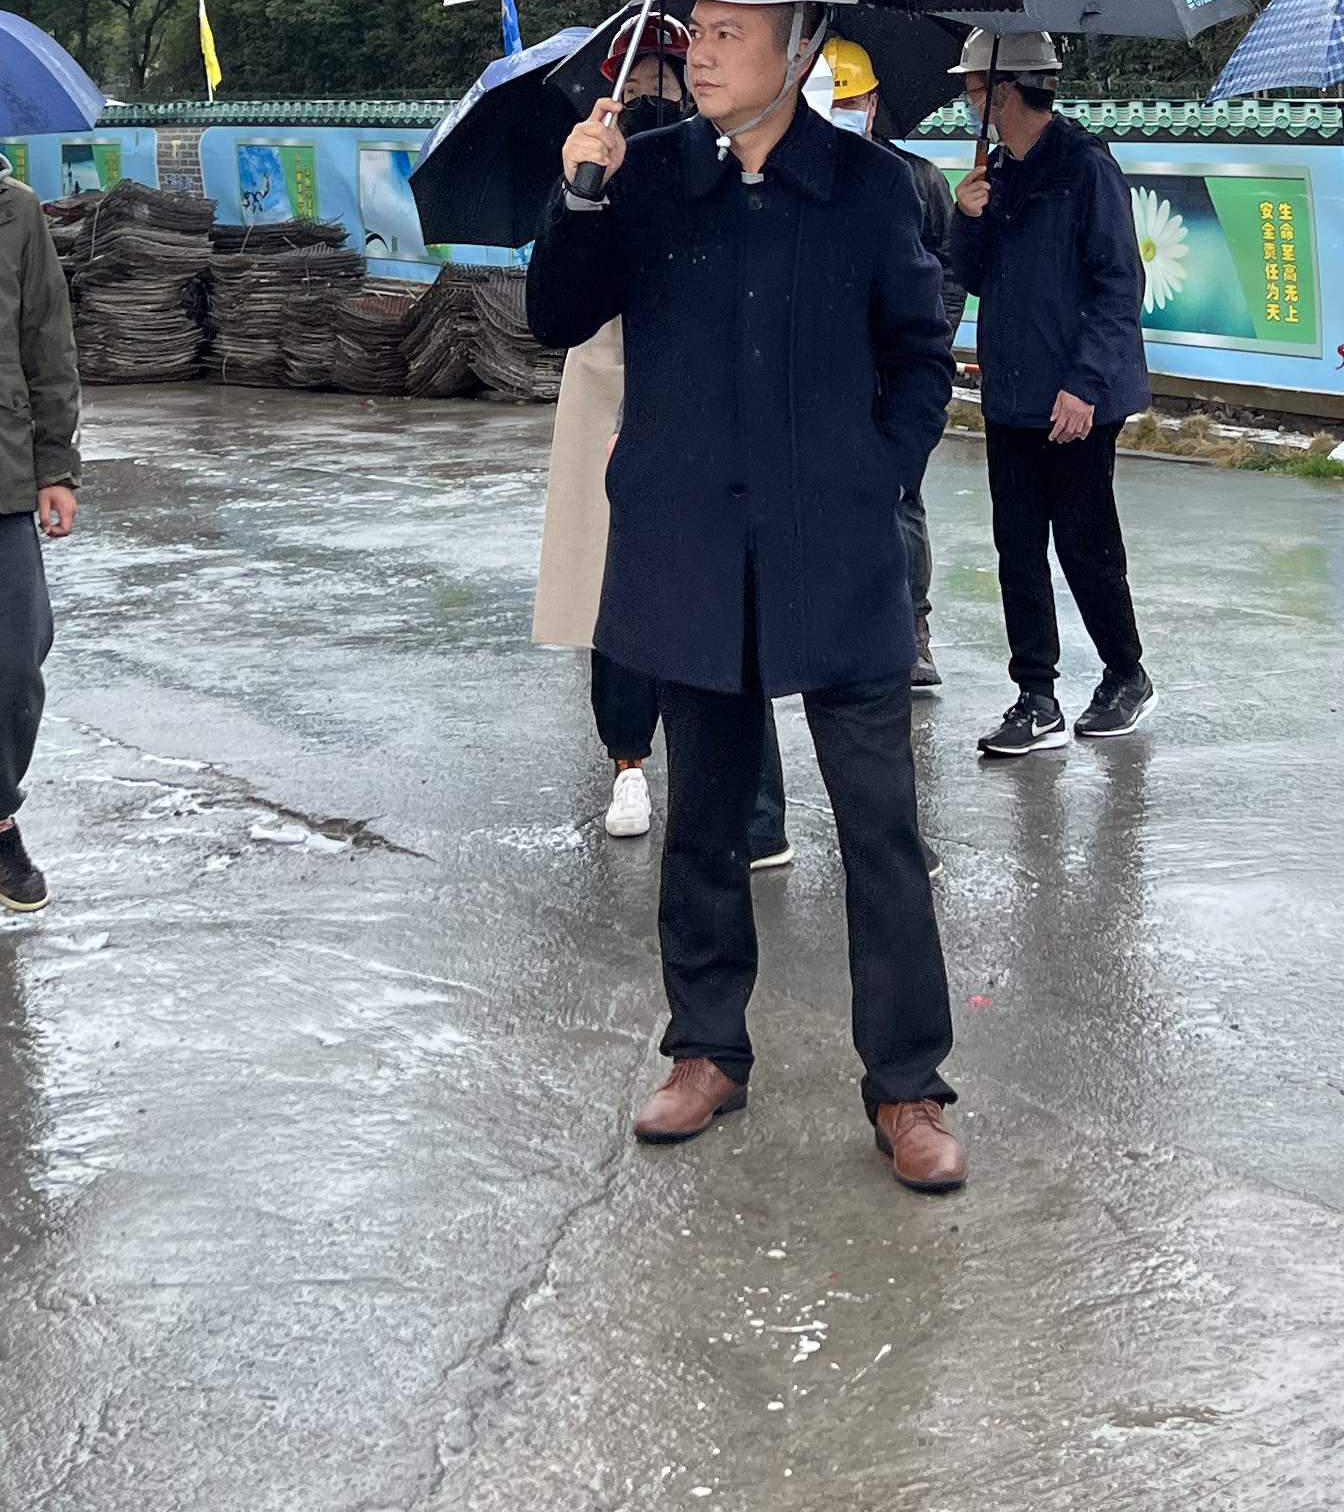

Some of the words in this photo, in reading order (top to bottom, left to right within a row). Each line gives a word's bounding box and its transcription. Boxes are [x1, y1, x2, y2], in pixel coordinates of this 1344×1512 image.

[1259, 201, 1282, 322] 安全责任为天
[1278, 202, 1301, 324] 生命至高无上
